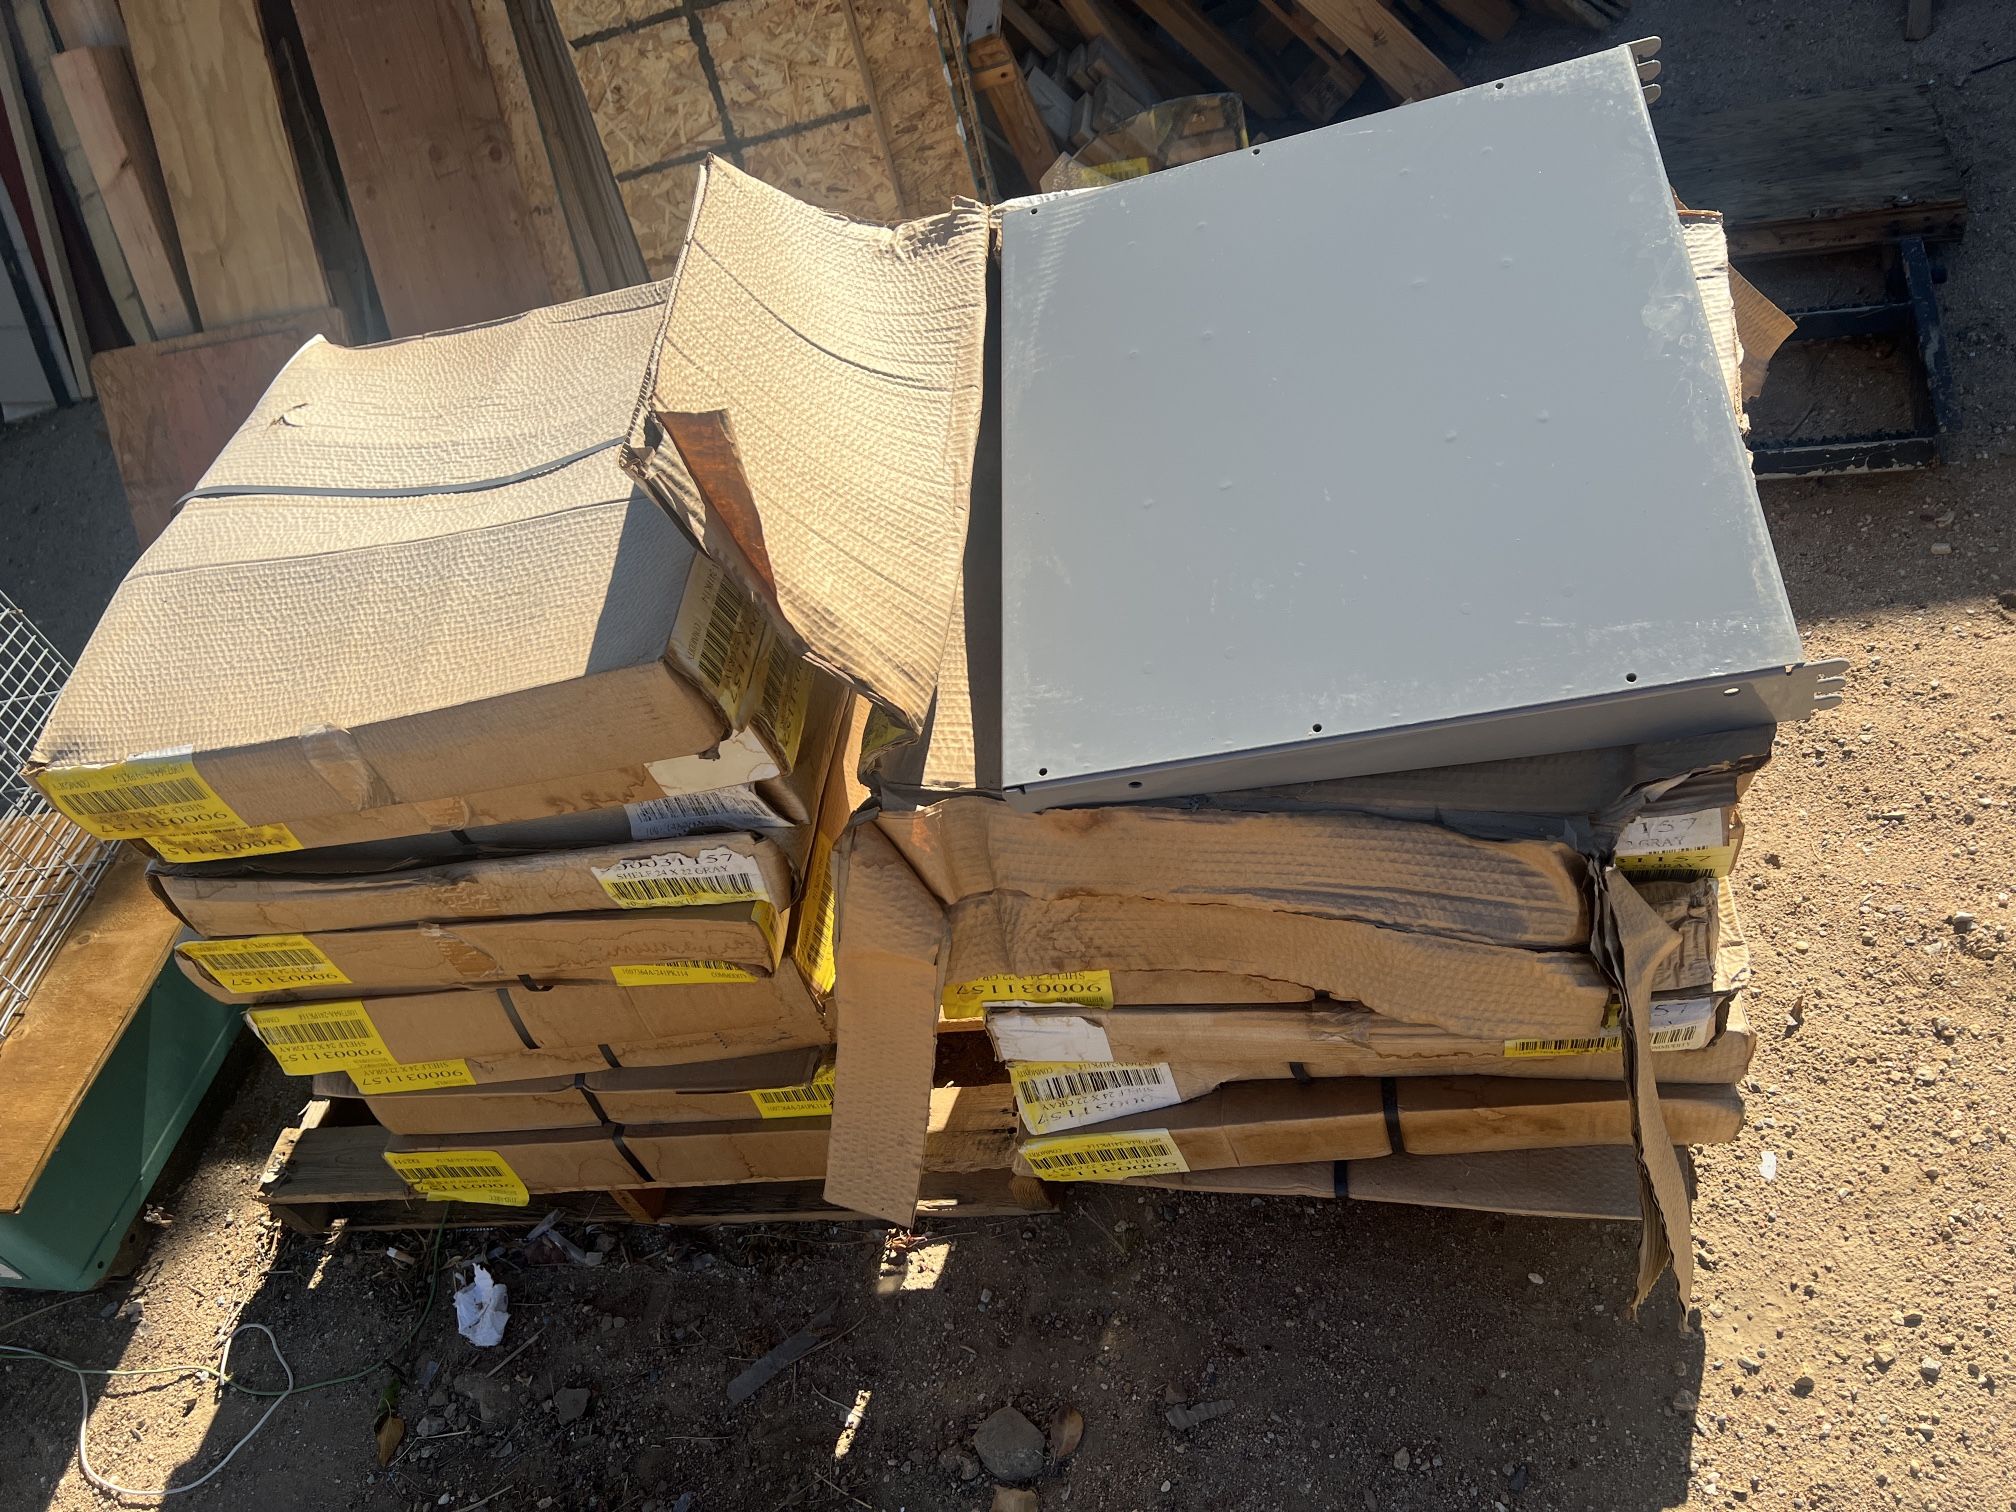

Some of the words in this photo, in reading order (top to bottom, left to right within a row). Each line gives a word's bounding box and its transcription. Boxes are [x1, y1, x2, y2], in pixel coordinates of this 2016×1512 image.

[101, 811, 228, 833] 900031157
[616, 869, 652, 880] SHELF
[655, 869, 668, 878] 24
[694, 864, 729, 875] GRAY
[231, 973, 338, 986] 900031157
[956, 983, 1102, 995] 900031157
[339, 1040, 367, 1049] SHELF
[279, 1047, 383, 1063] 900031157
[362, 1070, 463, 1086] 900031157
[1091, 1094, 1101, 1102] X
[1103, 1091, 1114, 1100] 24
[1041, 1100, 1074, 1111] GRAY
